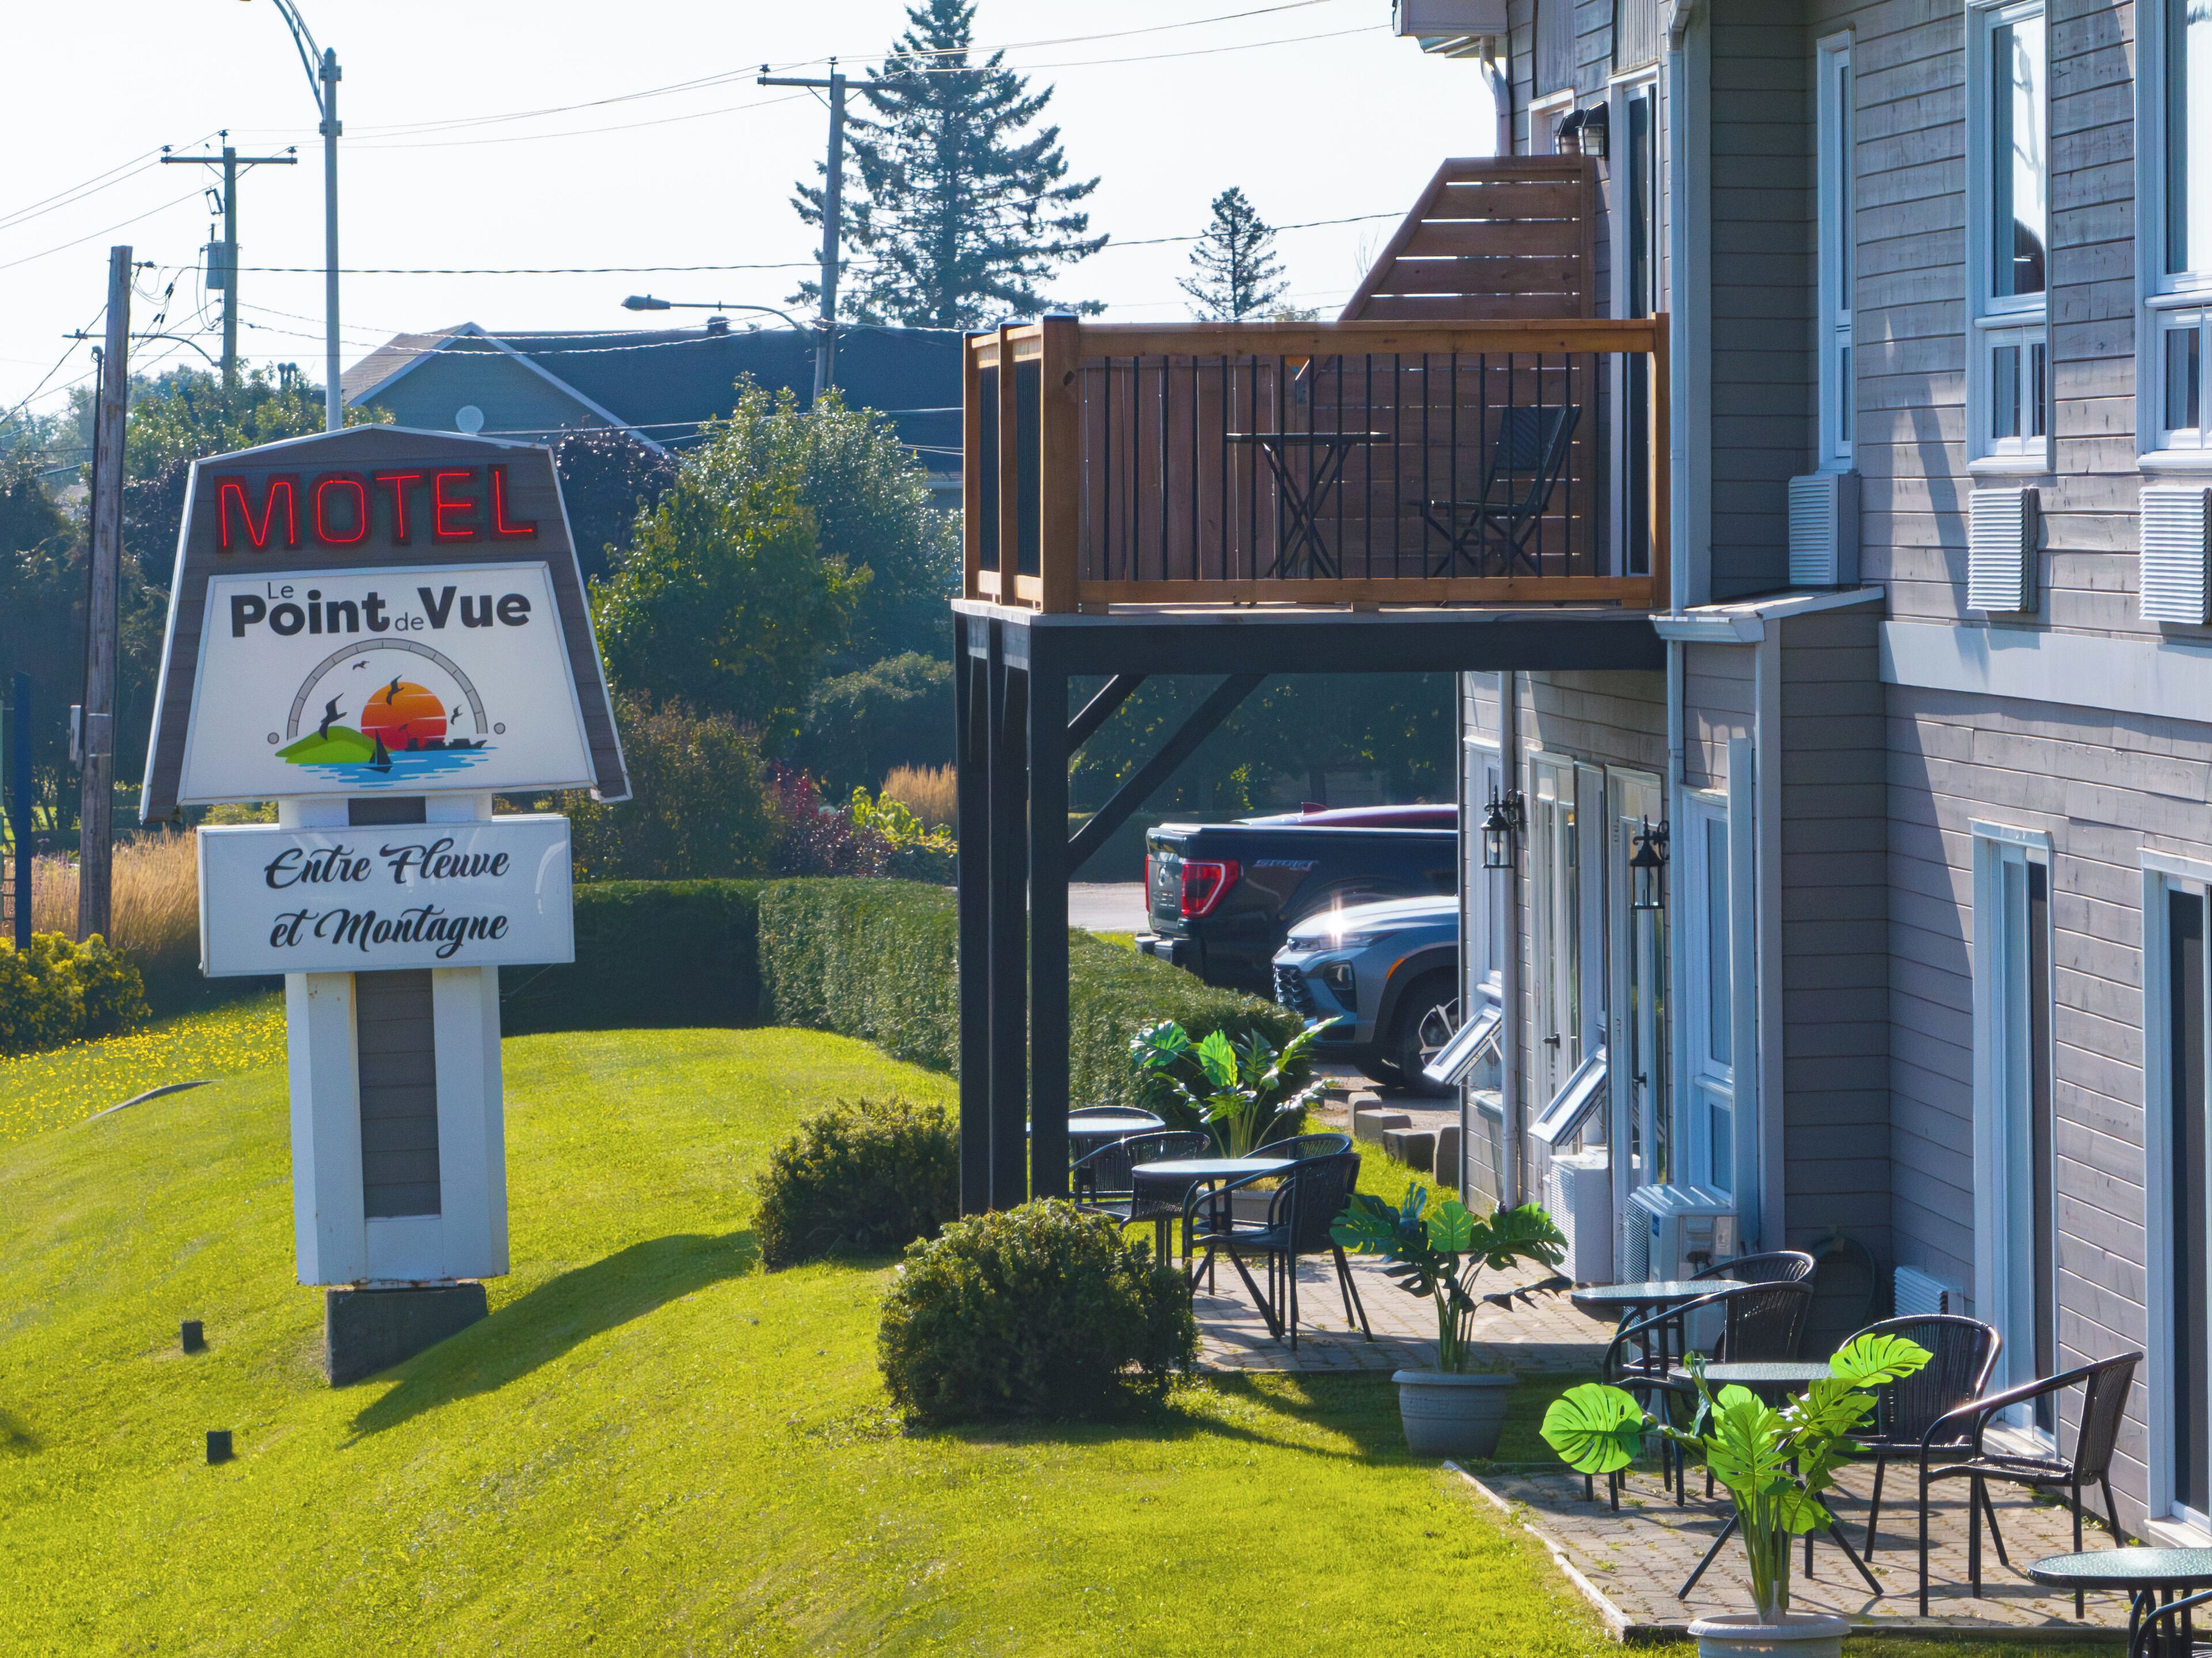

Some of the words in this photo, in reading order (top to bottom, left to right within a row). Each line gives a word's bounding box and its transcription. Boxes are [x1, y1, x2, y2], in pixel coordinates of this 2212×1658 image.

[214, 464, 538, 552] MOTEL
[230, 589, 391, 638] Point
[395, 612, 424, 631] de
[416, 585, 532, 630] Vue
[267, 582, 294, 600] Le
[264, 844, 372, 889] Entre
[378, 837, 510, 885] Fleuve
[269, 908, 320, 948] et
[313, 903, 509, 959] Montagne
